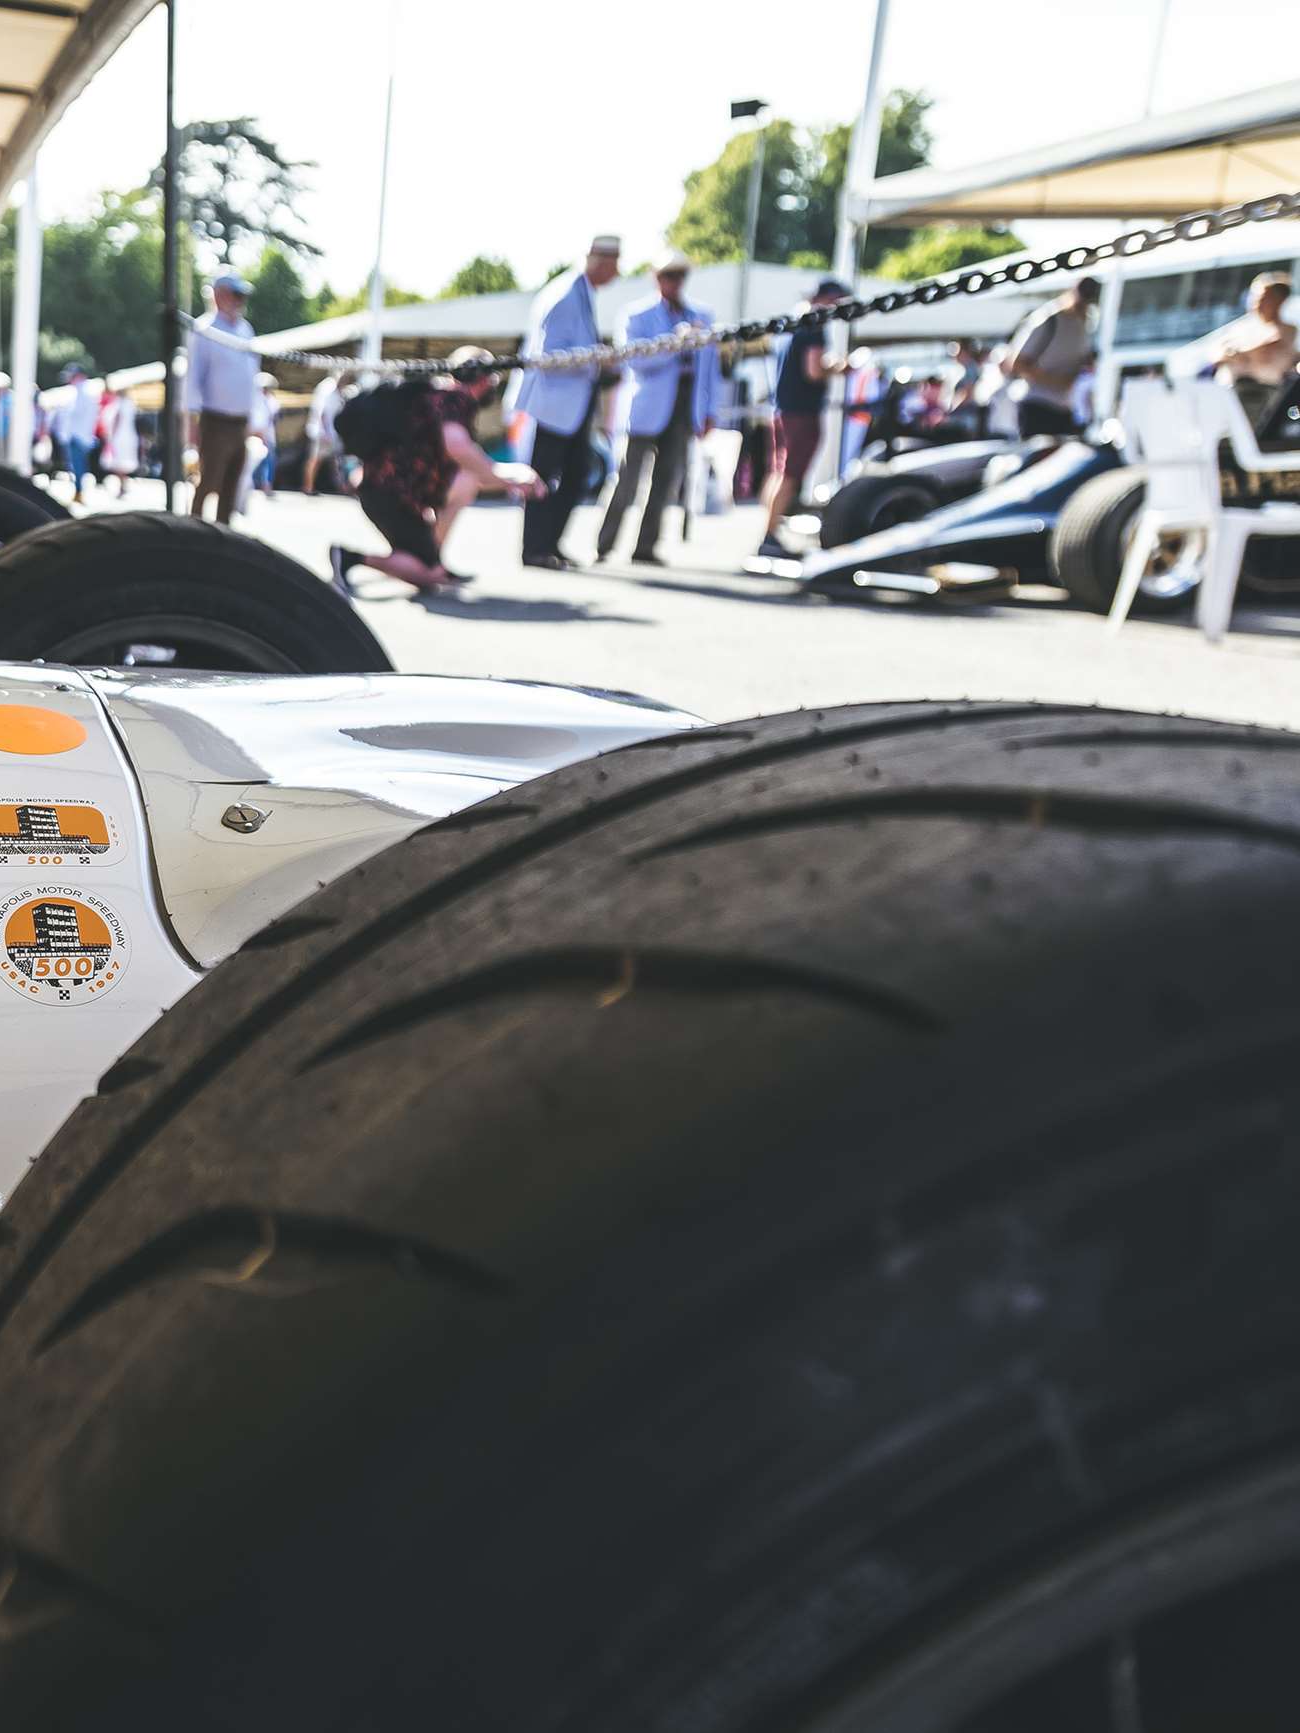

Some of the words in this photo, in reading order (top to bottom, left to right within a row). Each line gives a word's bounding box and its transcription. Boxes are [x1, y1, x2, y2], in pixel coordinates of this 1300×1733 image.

[27, 856, 63, 865] 500
[36, 886, 83, 899] MOTOR
[86, 896, 126, 950] SPEEDWAY
[0, 961, 40, 994] USAC
[35, 957, 93, 977] 500
[88, 961, 120, 993] 1967
